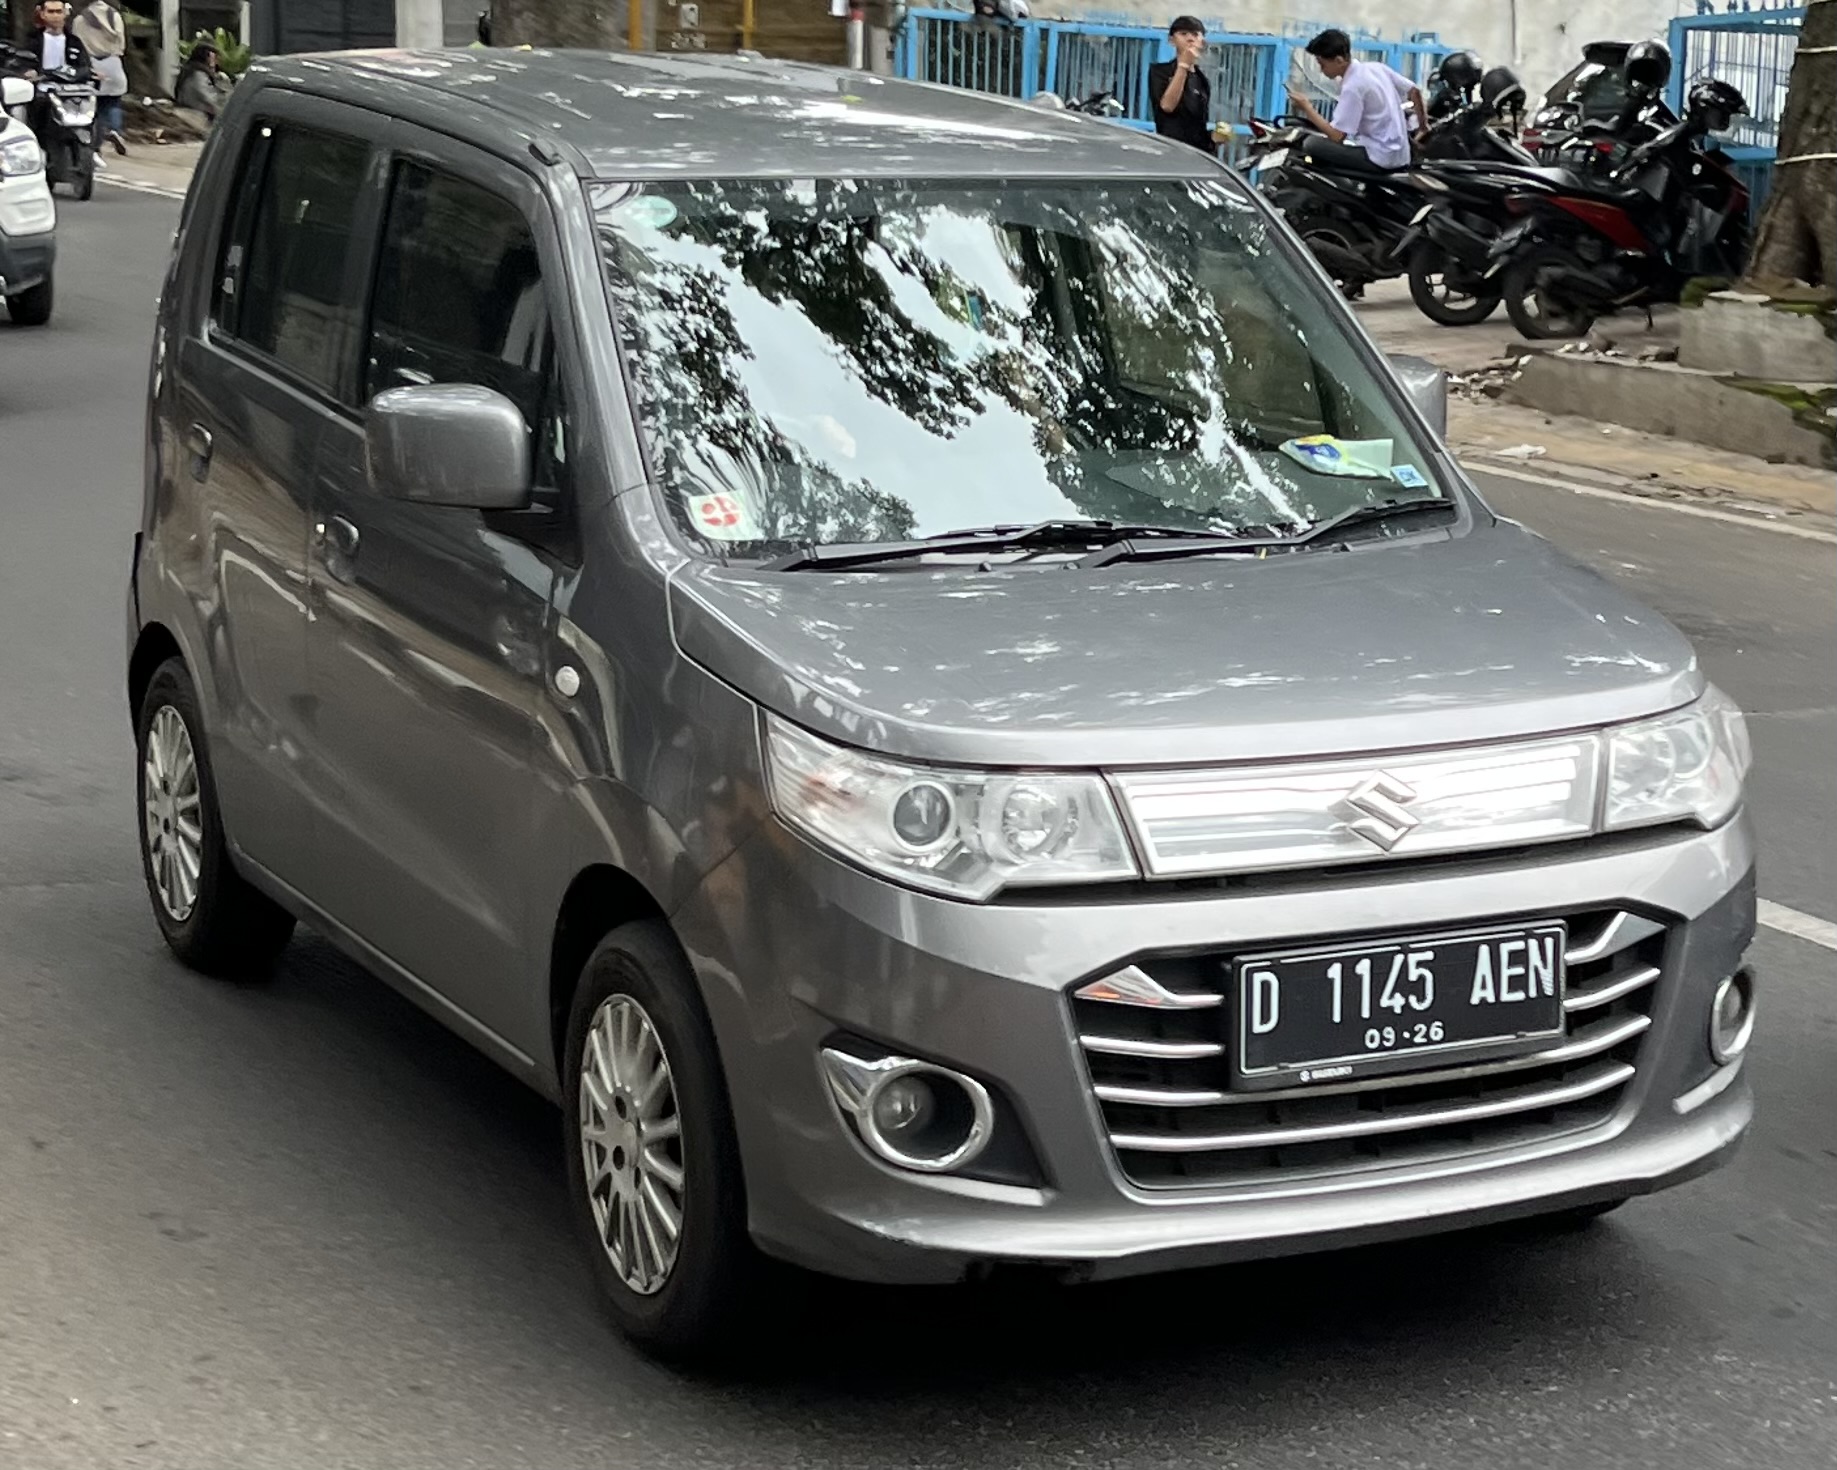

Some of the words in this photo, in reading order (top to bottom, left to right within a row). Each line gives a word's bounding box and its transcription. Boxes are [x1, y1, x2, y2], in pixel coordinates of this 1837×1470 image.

[1251, 971, 1280, 1034] D
[1326, 950, 1435, 1023] 1145
[1469, 936, 1555, 1005] AEN
